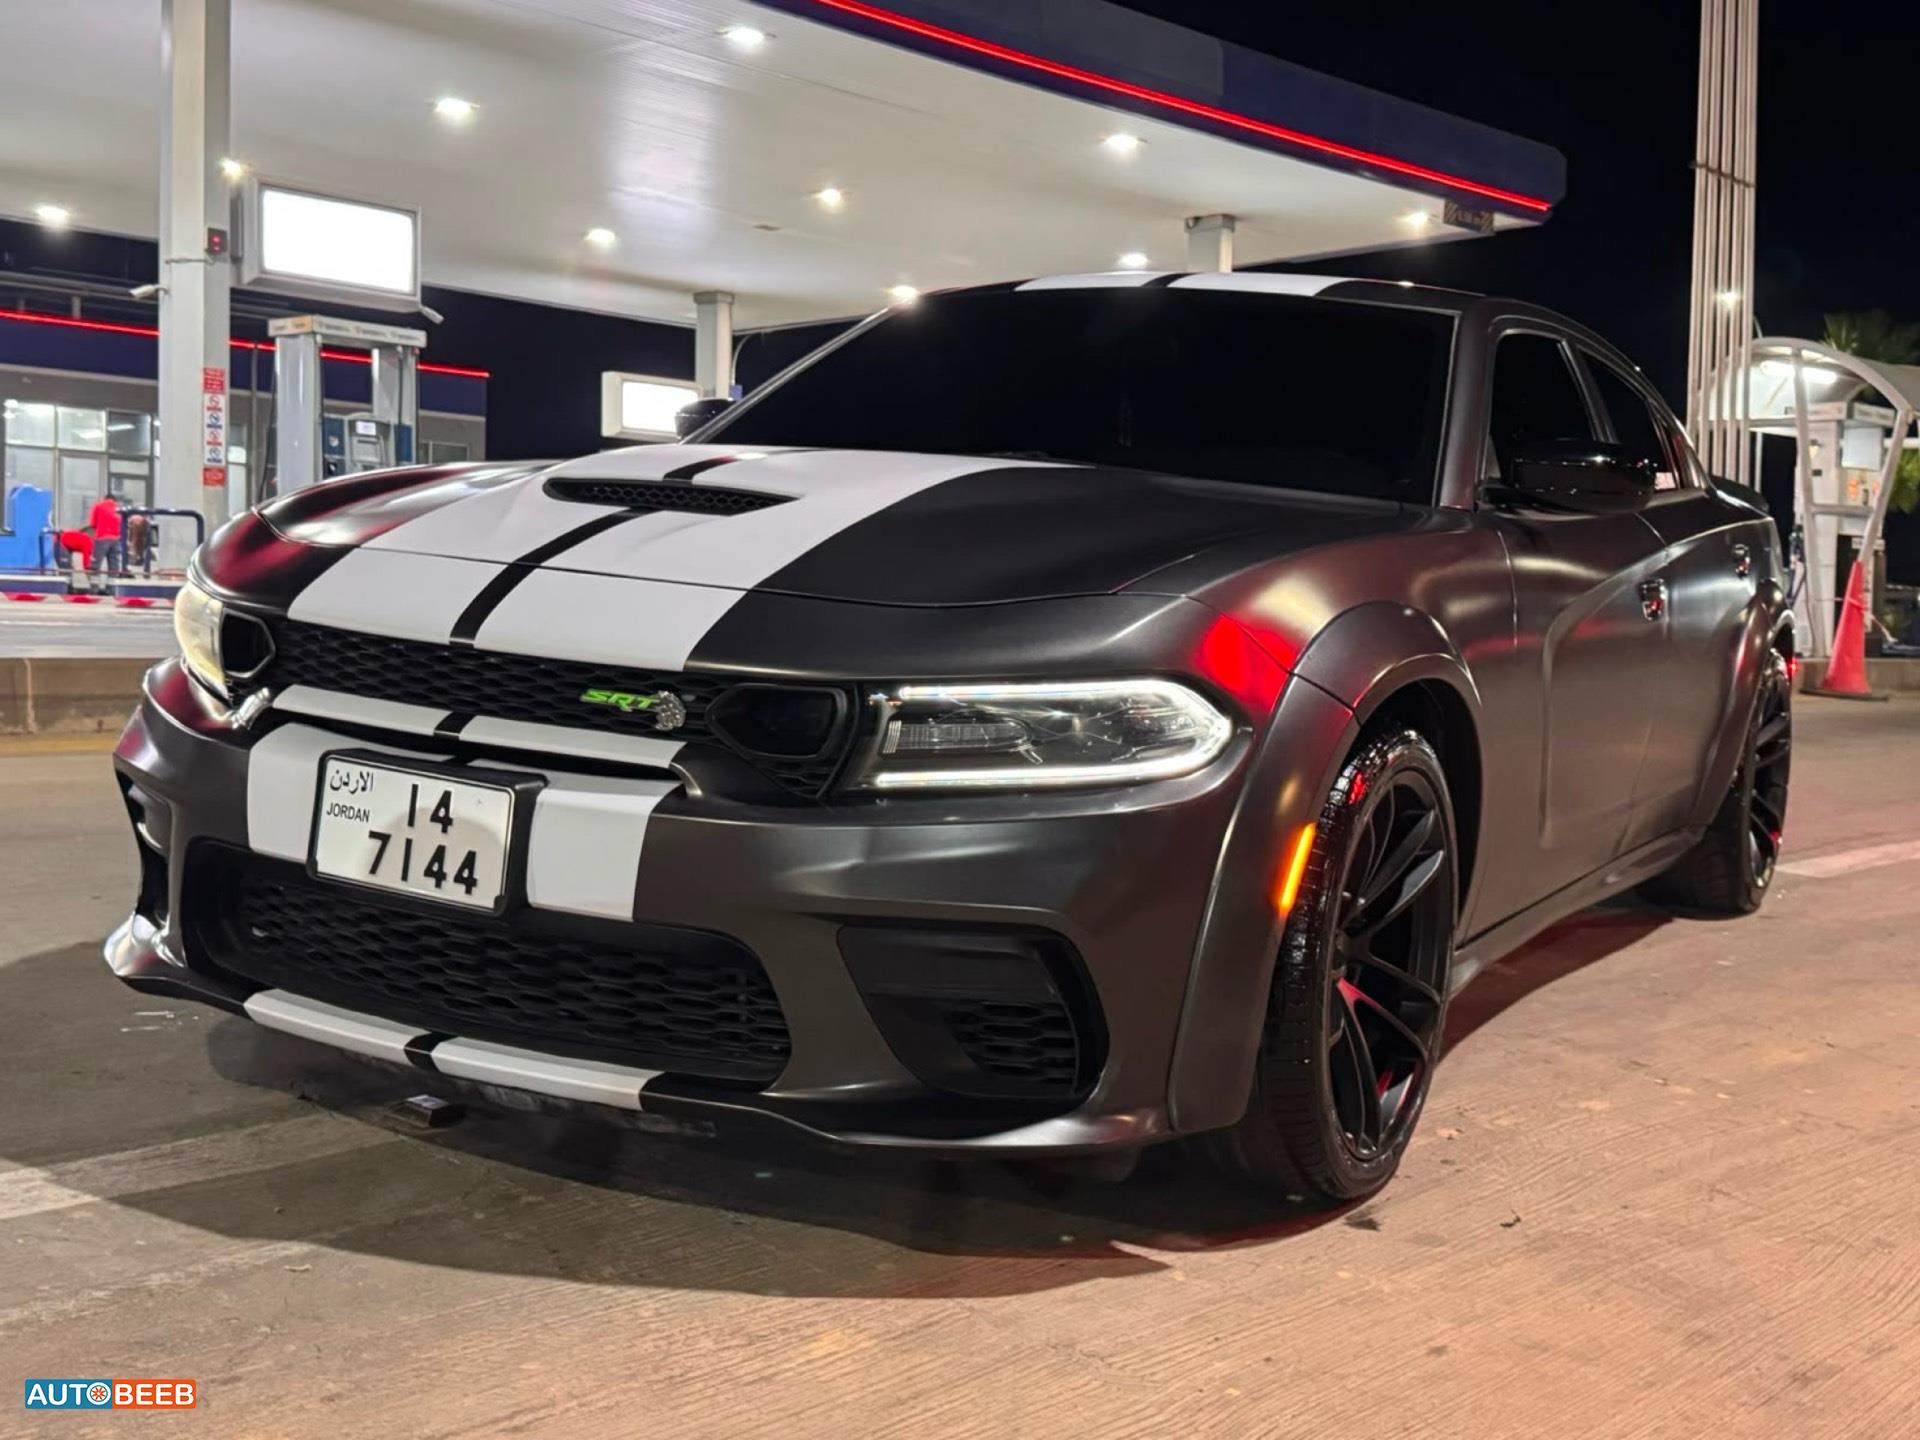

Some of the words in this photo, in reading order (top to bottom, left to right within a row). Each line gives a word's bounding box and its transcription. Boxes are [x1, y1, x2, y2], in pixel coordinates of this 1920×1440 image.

[580, 688, 660, 712] SRT
[326, 802, 370, 823] JORDAN
[407, 783, 453, 834] 14
[368, 830, 477, 895] 7144
